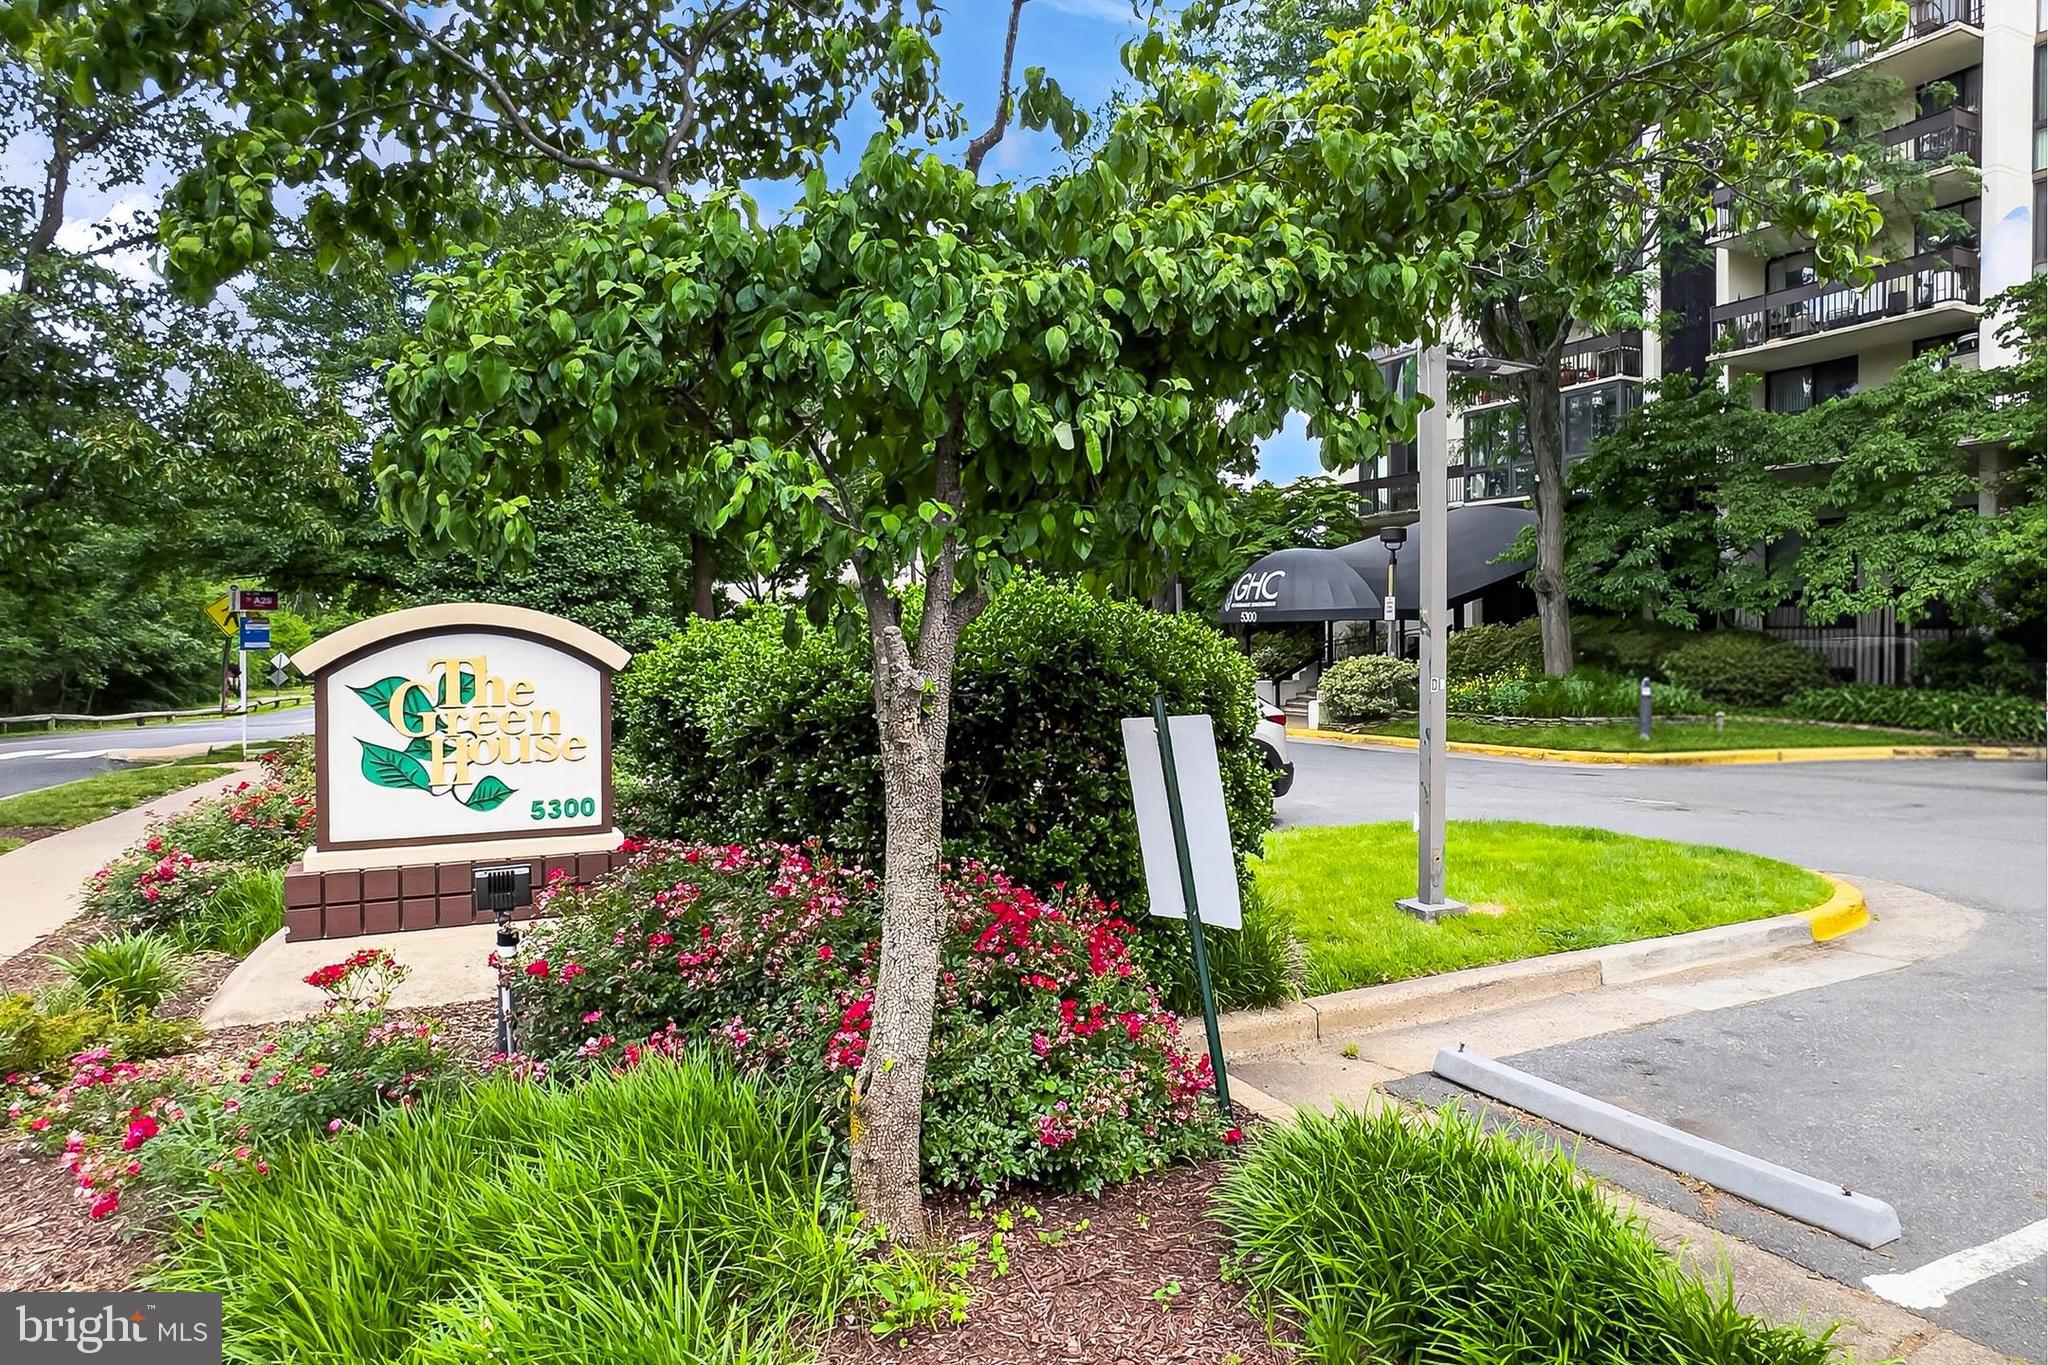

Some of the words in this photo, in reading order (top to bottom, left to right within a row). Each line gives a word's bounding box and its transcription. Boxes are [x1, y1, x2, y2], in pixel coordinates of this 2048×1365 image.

[1234, 570, 1286, 601] GHC
[1240, 611, 1258, 623] 5300
[427, 654, 535, 709] The
[389, 680, 562, 739] Green
[428, 733, 588, 787] House
[530, 797, 595, 820] 5300
